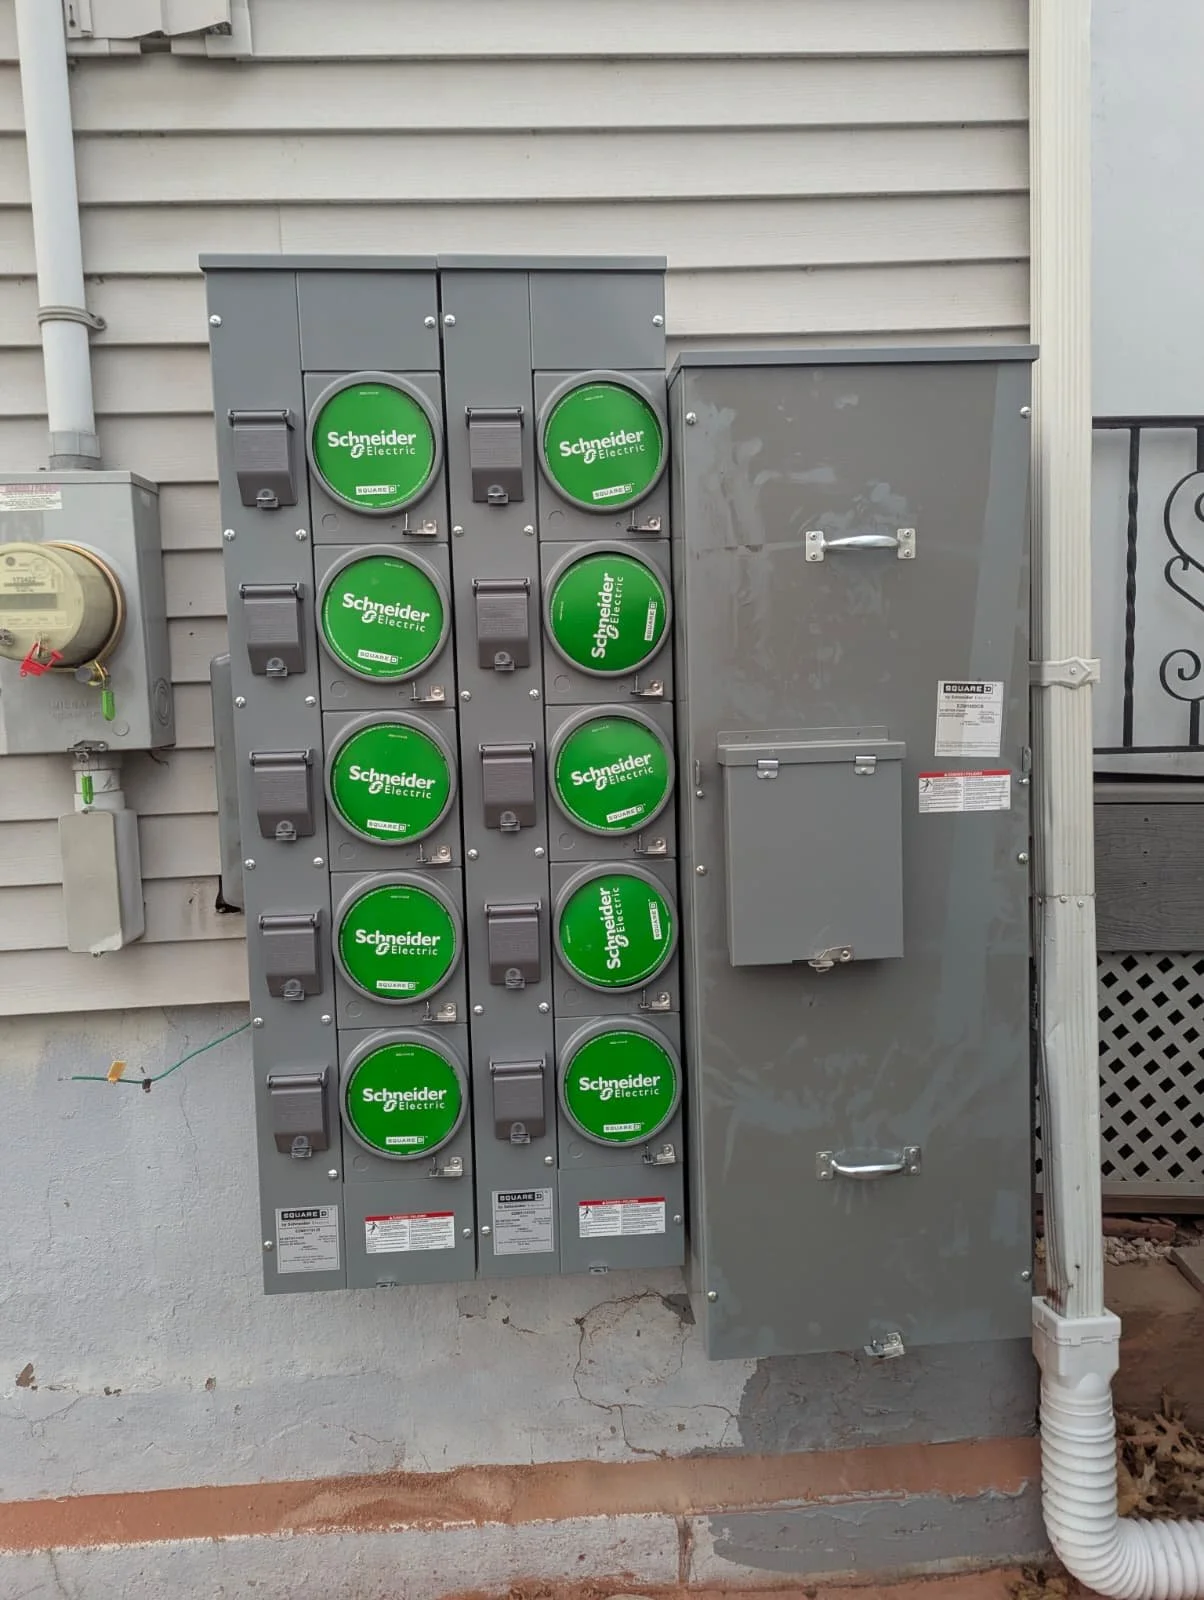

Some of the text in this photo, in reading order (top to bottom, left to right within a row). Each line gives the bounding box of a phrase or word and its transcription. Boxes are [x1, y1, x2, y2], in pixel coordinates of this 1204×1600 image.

[328, 430, 416, 447] Schneider
[560, 430, 644, 456] Schneider
[367, 446, 416, 456] Electric
[599, 444, 645, 459] Electric
[357, 486, 388, 494] SQUARE
[593, 487, 624, 498] SQUARE
[342, 593, 430, 622] Schneider
[611, 577, 623, 624] Electric
[591, 572, 614, 658] Schneider
[378, 614, 426, 632] Electric
[359, 650, 390, 662] SQUARE
[349, 765, 436, 789] Schneider
[571, 754, 651, 785] Schneider
[609, 766, 654, 784] Electric
[385, 785, 431, 799] Electric
[608, 808, 635, 821] SQUARE
[368, 820, 398, 830] SQUARE
[612, 887, 625, 932] Electric
[599, 888, 621, 969] Schneider
[650, 909, 661, 939] SQUARE
[355, 929, 440, 946] Schneider
[391, 945, 438, 956] Electric
[378, 981, 407, 989] SQUARE
[579, 1074, 660, 1090] Schneider
[362, 1087, 447, 1102] Schneider
[615, 1088, 660, 1098] Electric
[399, 1102, 445, 1110] Electric
[283, 1211, 318, 1219] SQUARE
